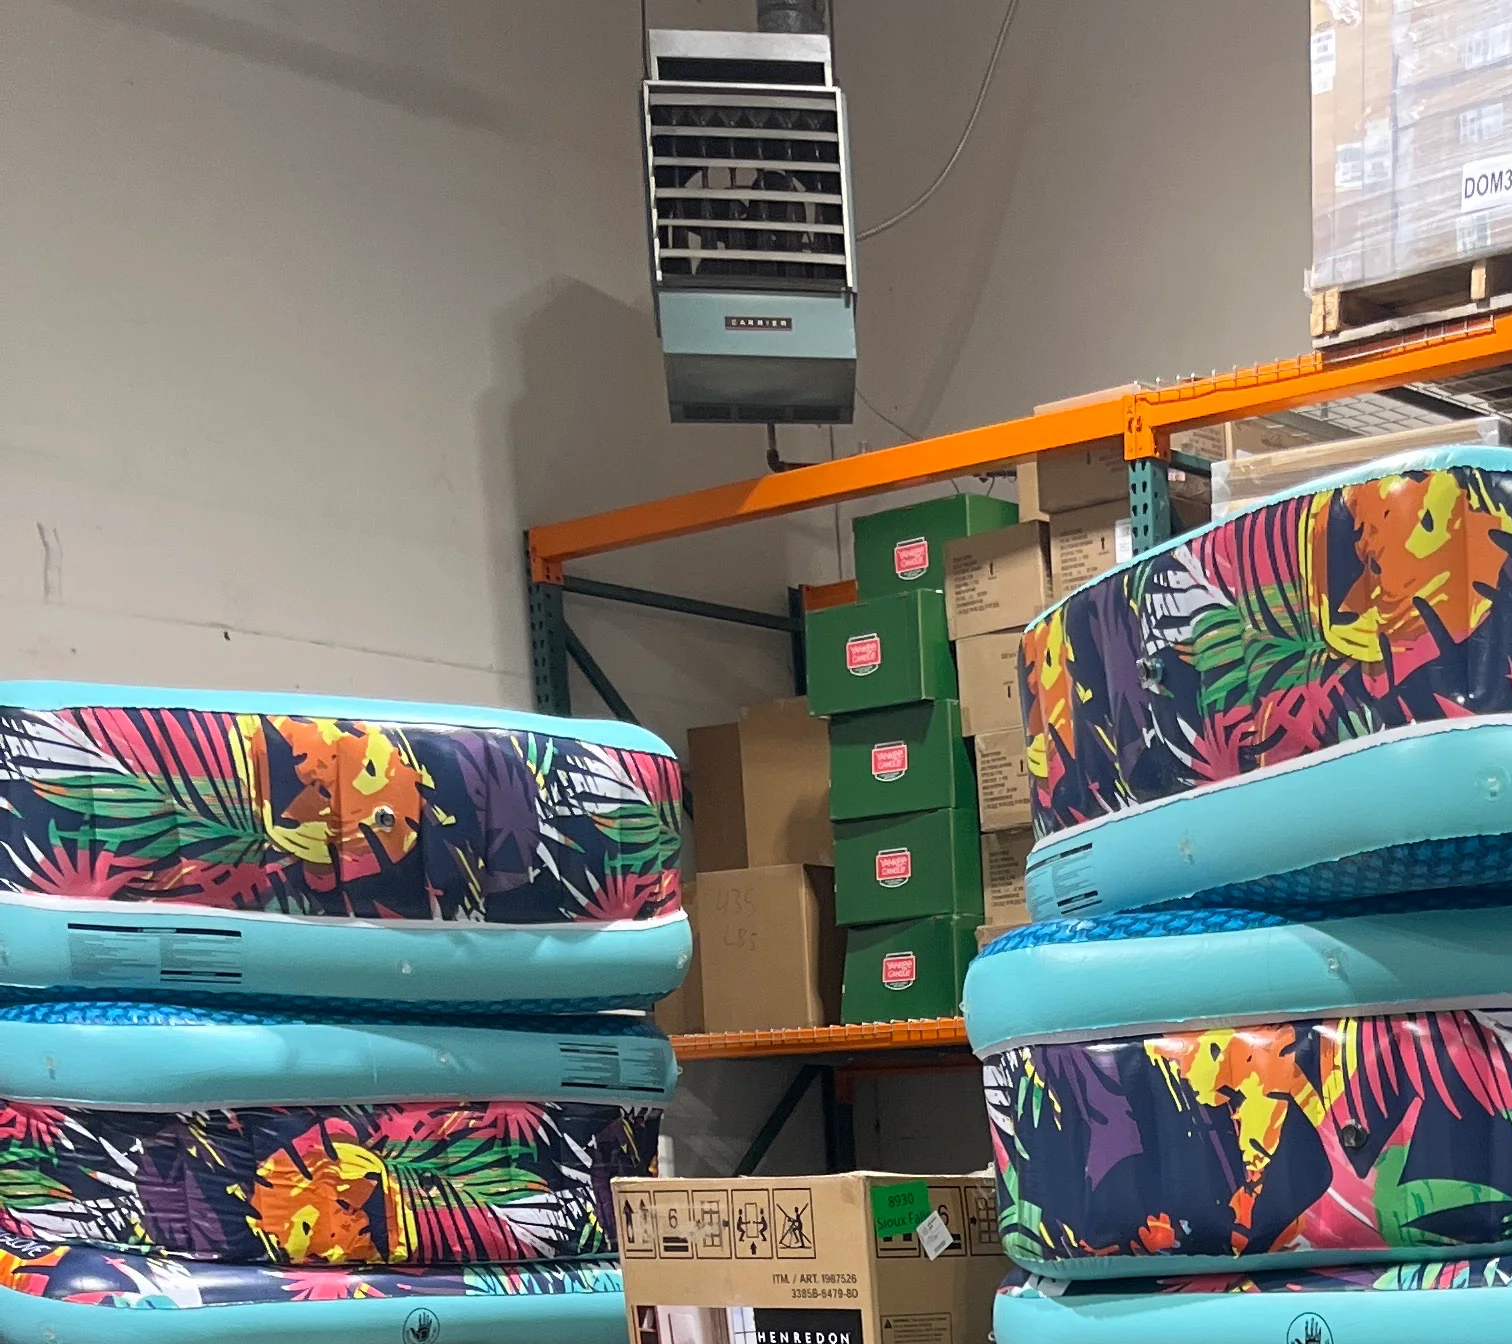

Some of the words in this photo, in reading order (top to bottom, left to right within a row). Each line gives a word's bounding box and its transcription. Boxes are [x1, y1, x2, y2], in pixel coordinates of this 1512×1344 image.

[1464, 168, 1512, 199] DOM3
[888, 1192, 914, 1208] 8930
[877, 1216, 906, 1230] Sioux
[821, 1274, 857, 1284] 1987526
[758, 1331, 850, 1344] HENREDON
